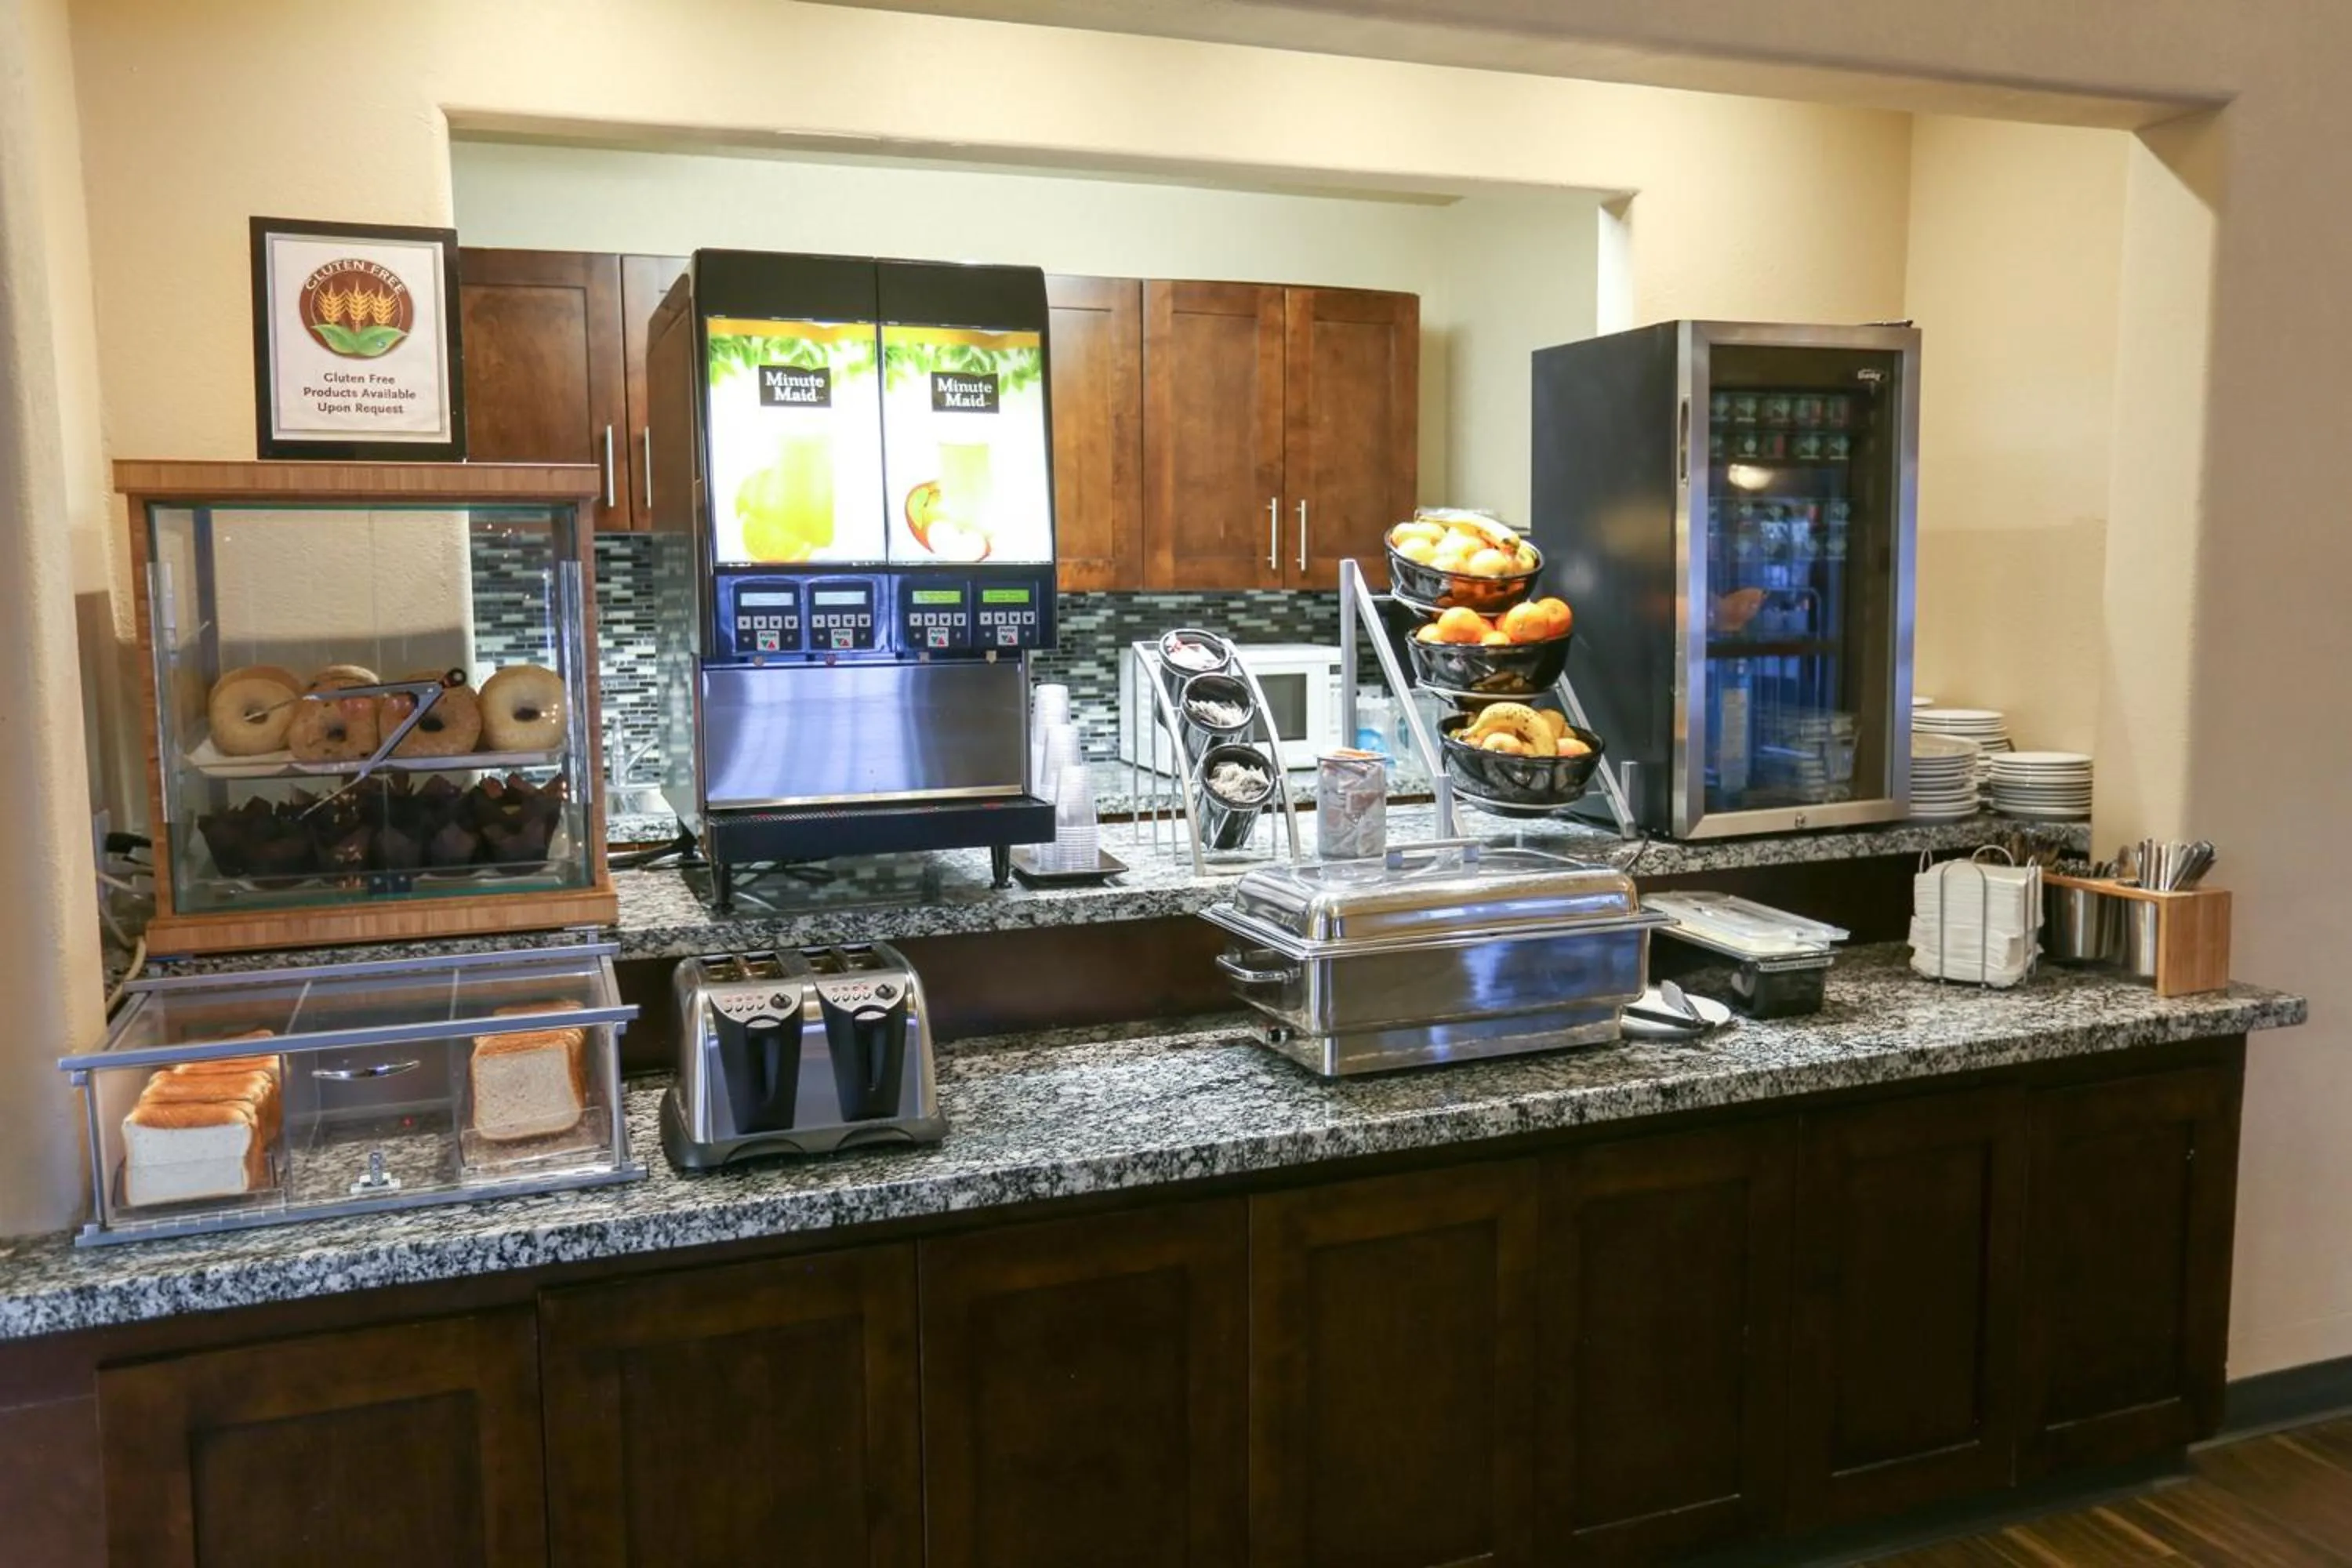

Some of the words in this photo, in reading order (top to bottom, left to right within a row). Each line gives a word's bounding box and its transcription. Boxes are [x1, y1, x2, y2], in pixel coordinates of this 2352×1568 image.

[306, 261, 365, 290] GLUTEN
[371, 264, 405, 294] FREE
[323, 372, 365, 383] Gluten
[368, 374, 396, 384] Free
[765, 371, 825, 388] Minute
[937, 377, 993, 393] Minute
[303, 387, 358, 398] Products
[361, 388, 416, 399] Available
[774, 387, 818, 402] Maid
[945, 392, 985, 407] Maid
[318, 401, 351, 414] Upon
[355, 402, 404, 416] Request
